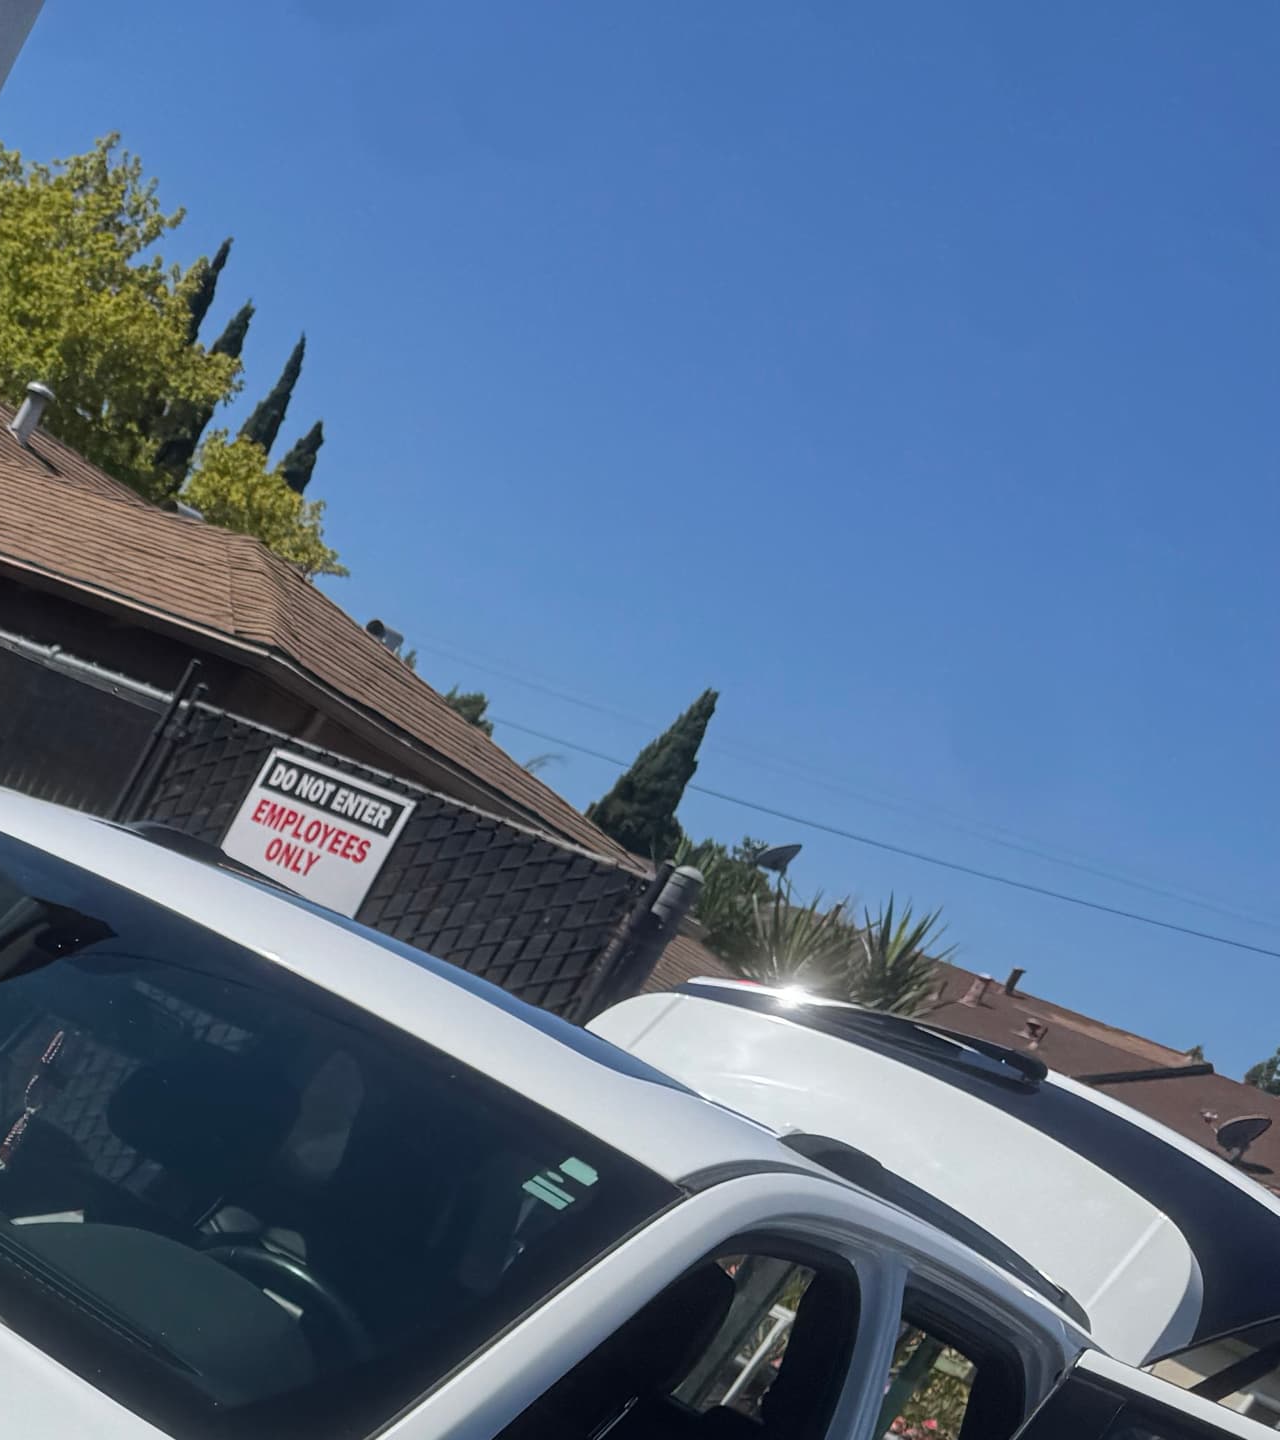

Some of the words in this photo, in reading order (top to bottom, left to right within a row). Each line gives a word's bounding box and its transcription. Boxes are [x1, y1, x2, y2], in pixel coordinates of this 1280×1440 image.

[268, 763, 297, 792] DO
[295, 771, 336, 806] NOT
[331, 788, 393, 830] ENTER
[251, 798, 372, 864] EMPLOYEES
[264, 837, 321, 877] ONLY
